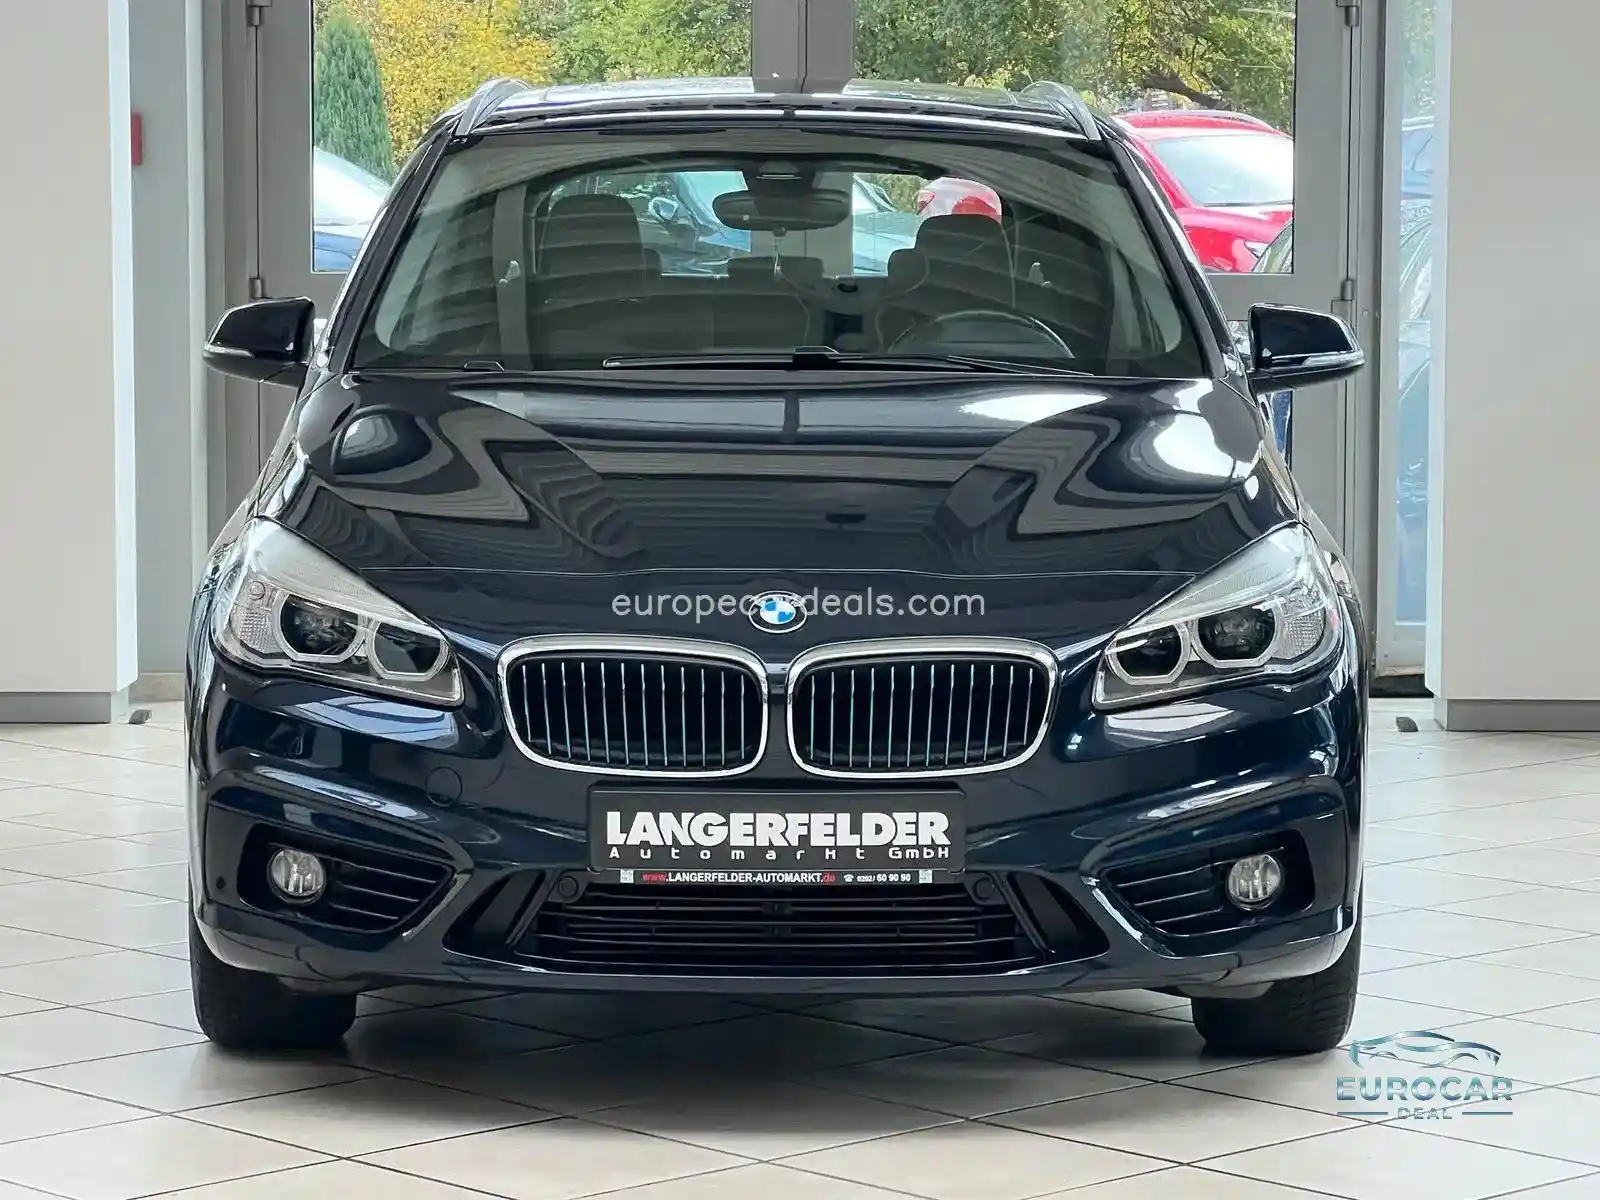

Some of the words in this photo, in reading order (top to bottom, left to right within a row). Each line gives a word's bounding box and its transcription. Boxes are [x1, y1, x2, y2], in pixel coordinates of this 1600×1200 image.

[606, 811, 951, 846] LANGERFELDER
[608, 846, 865, 860] Automarkt
[888, 846, 950, 860] GmbH
